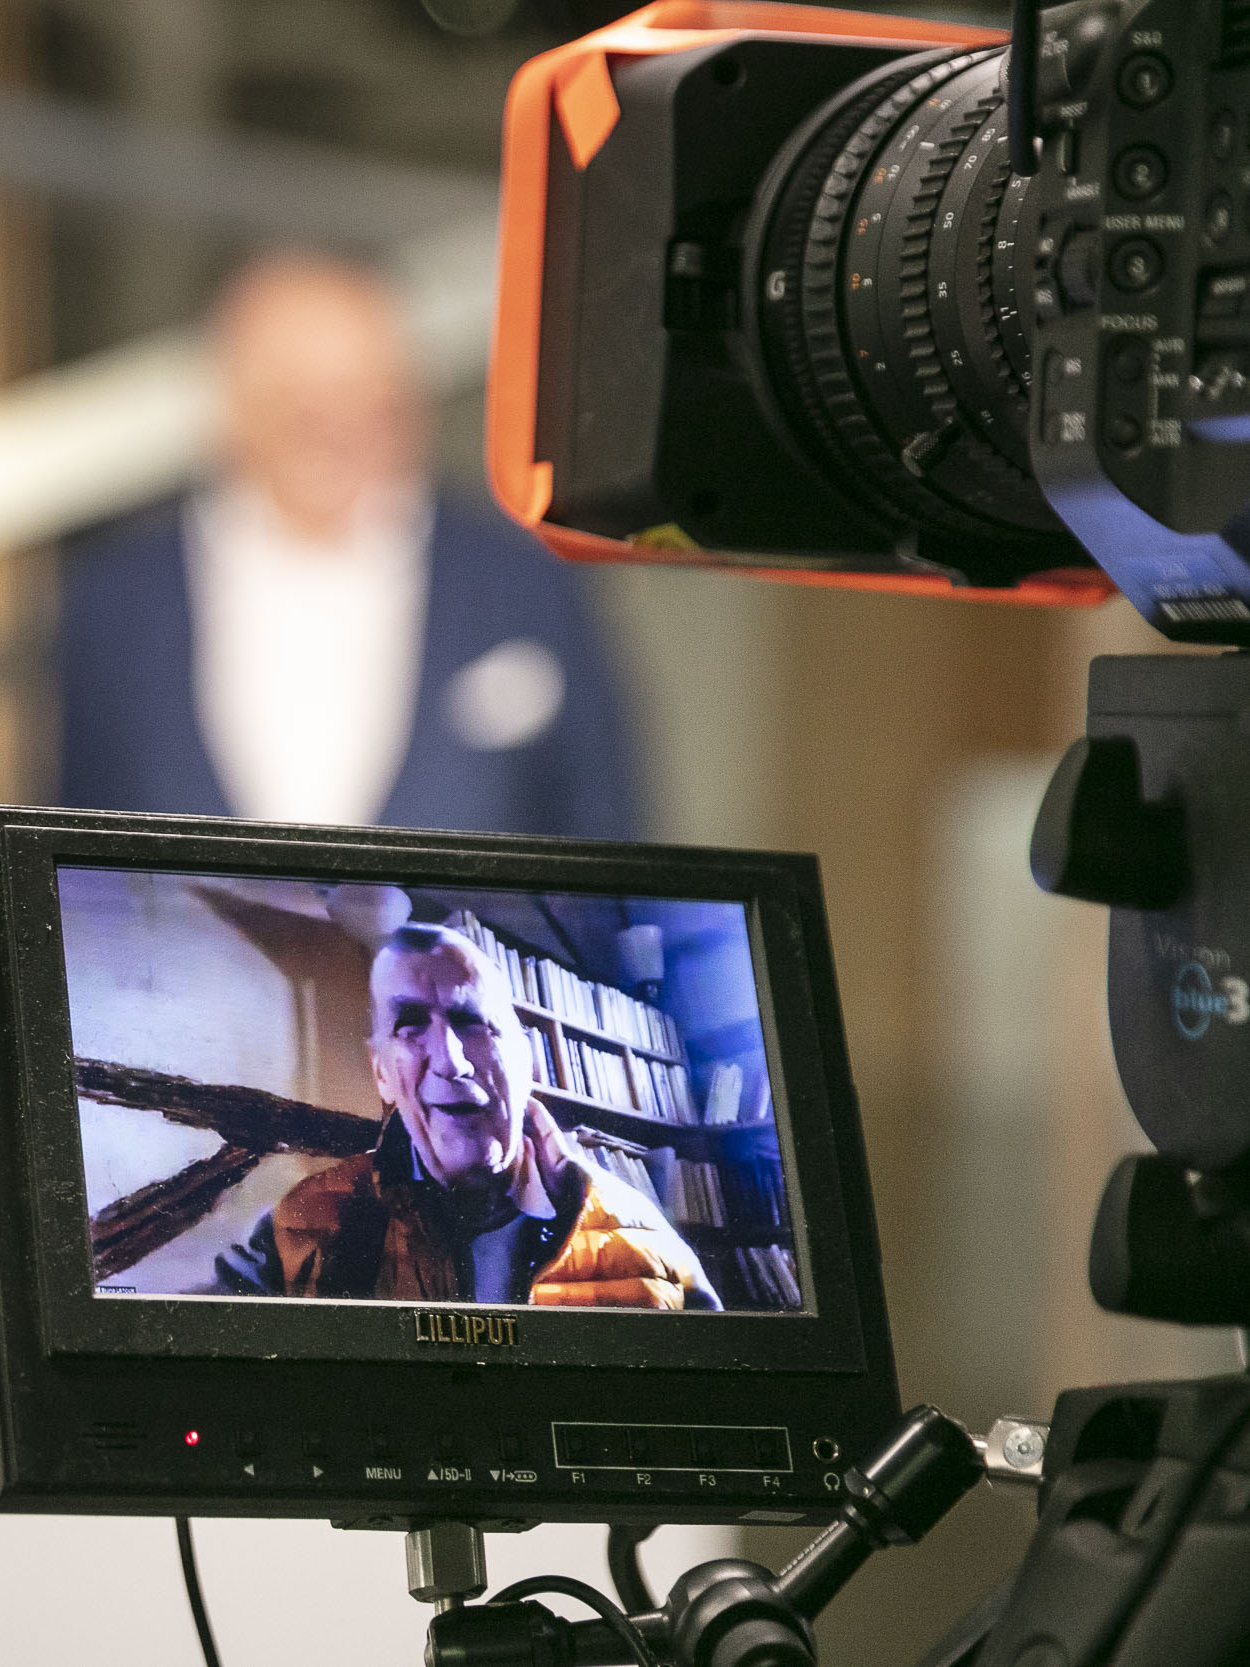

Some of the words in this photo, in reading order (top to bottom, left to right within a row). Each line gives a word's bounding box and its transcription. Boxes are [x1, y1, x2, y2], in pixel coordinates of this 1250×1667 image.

[963, 155, 978, 170] 70
[887, 164, 900, 181] 10
[943, 211, 955, 229] 50
[1104, 214, 1142, 231] USER
[1144, 214, 1186, 231] MENU
[997, 240, 1007, 249] 8
[851, 272, 862, 291] 10
[863, 277, 873, 287] 3
[938, 281, 948, 298] 35
[1000, 306, 1011, 321] 11
[1100, 313, 1159, 331] FOCUS
[951, 349, 964, 366] 25
[1021, 371, 1032, 386] 16
[415, 1312, 516, 1345] LILLIPUT
[366, 1467, 402, 1480] MENU
[572, 1472, 586, 1484] F1
[637, 1473, 652, 1485] F2
[700, 1474, 717, 1487] F3
[763, 1475, 780, 1488] F4
